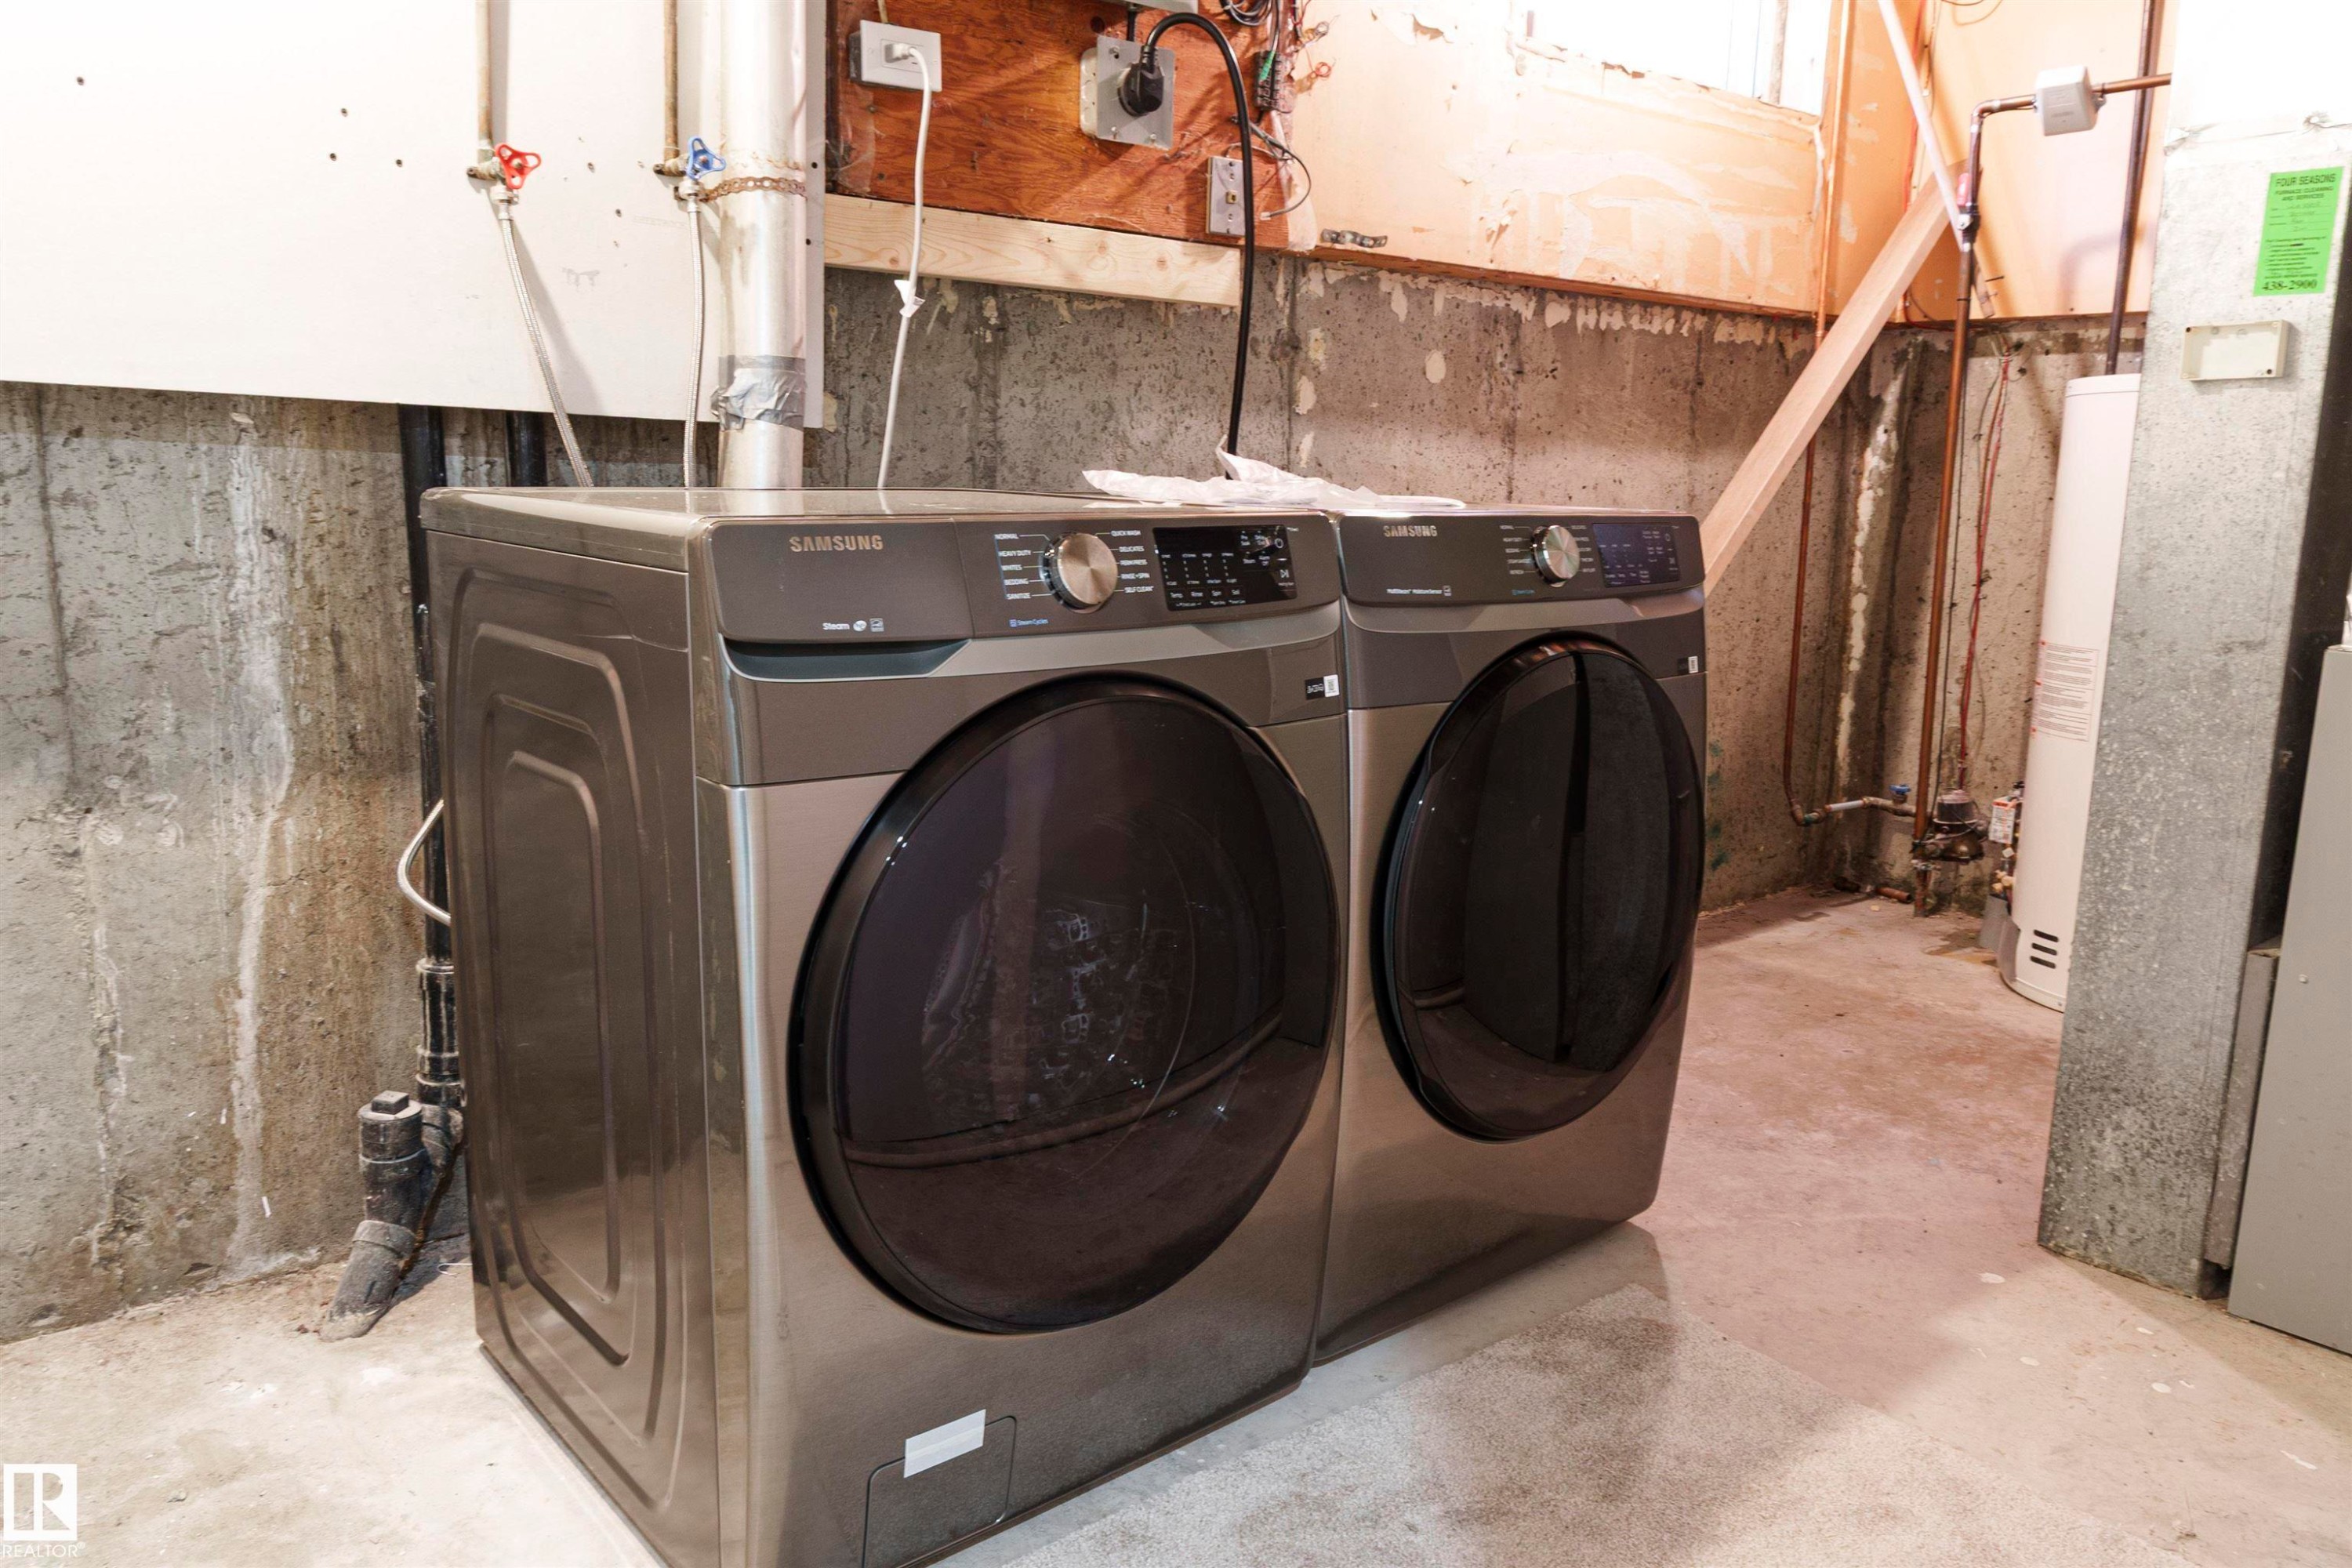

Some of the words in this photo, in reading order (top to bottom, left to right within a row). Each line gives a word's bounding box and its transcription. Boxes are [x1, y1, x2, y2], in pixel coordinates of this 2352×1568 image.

[2299, 173, 2336, 184] SEASONS
[1383, 525, 1438, 537] SAMSUNG
[789, 535, 884, 552] SAMSUNG
